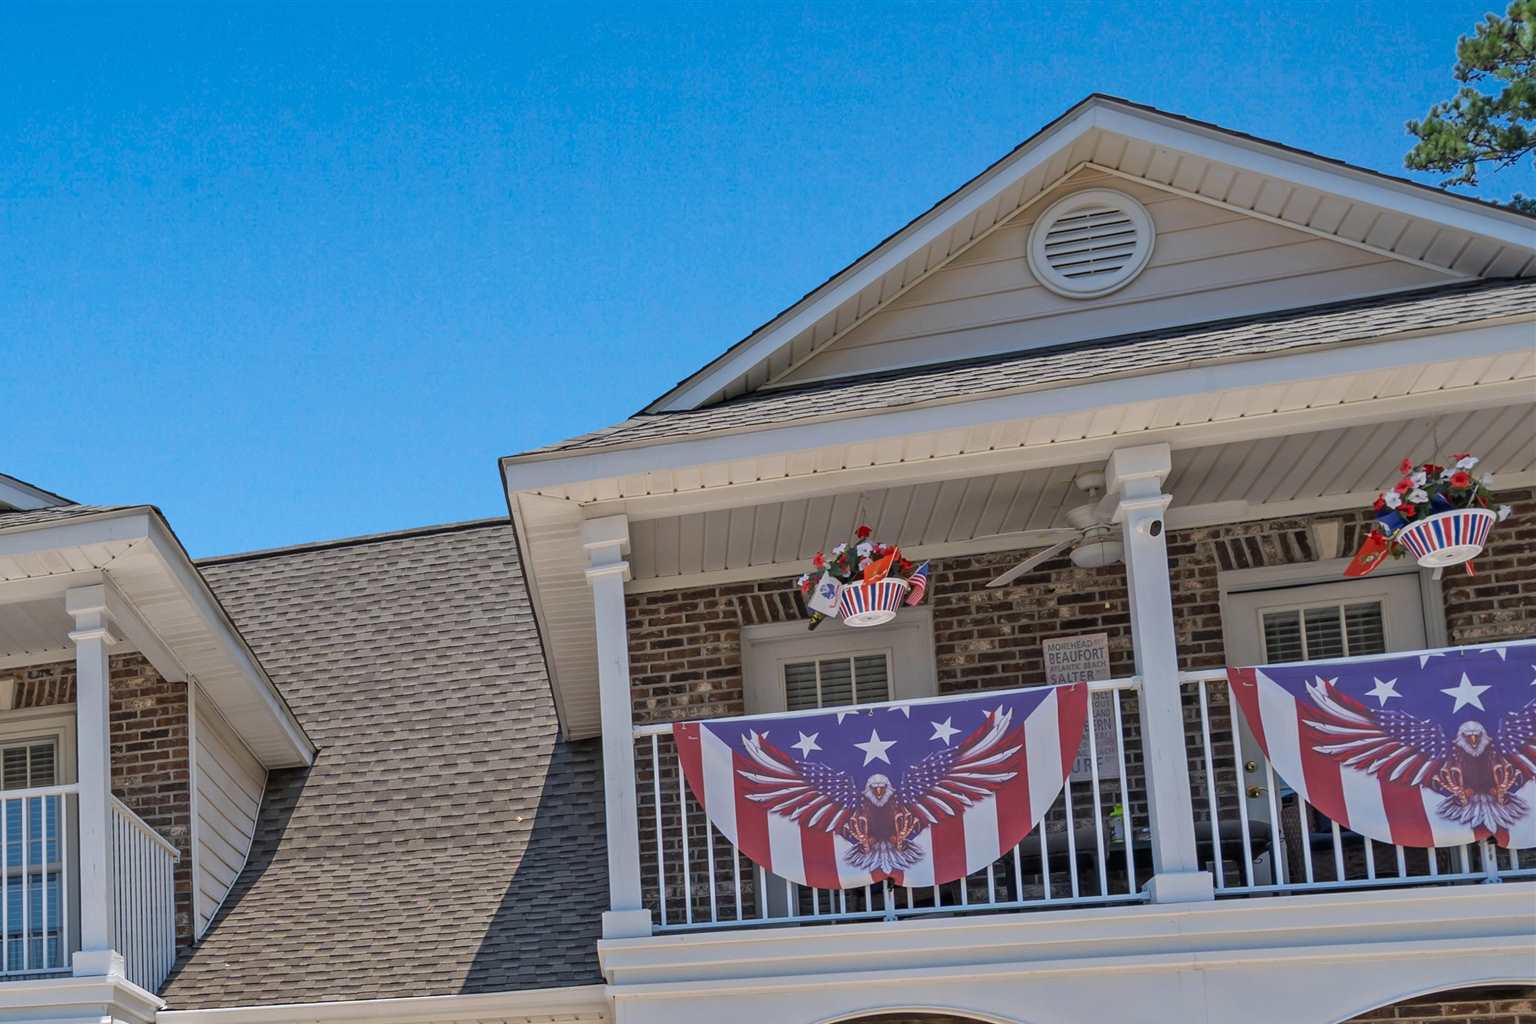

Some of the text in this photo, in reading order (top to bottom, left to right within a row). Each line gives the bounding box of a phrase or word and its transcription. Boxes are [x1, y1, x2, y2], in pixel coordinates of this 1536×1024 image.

[1049, 648, 1105, 664] BEAUFORT
[1084, 660, 1106, 669] BEACH
[1050, 670, 1095, 685] SALTER
